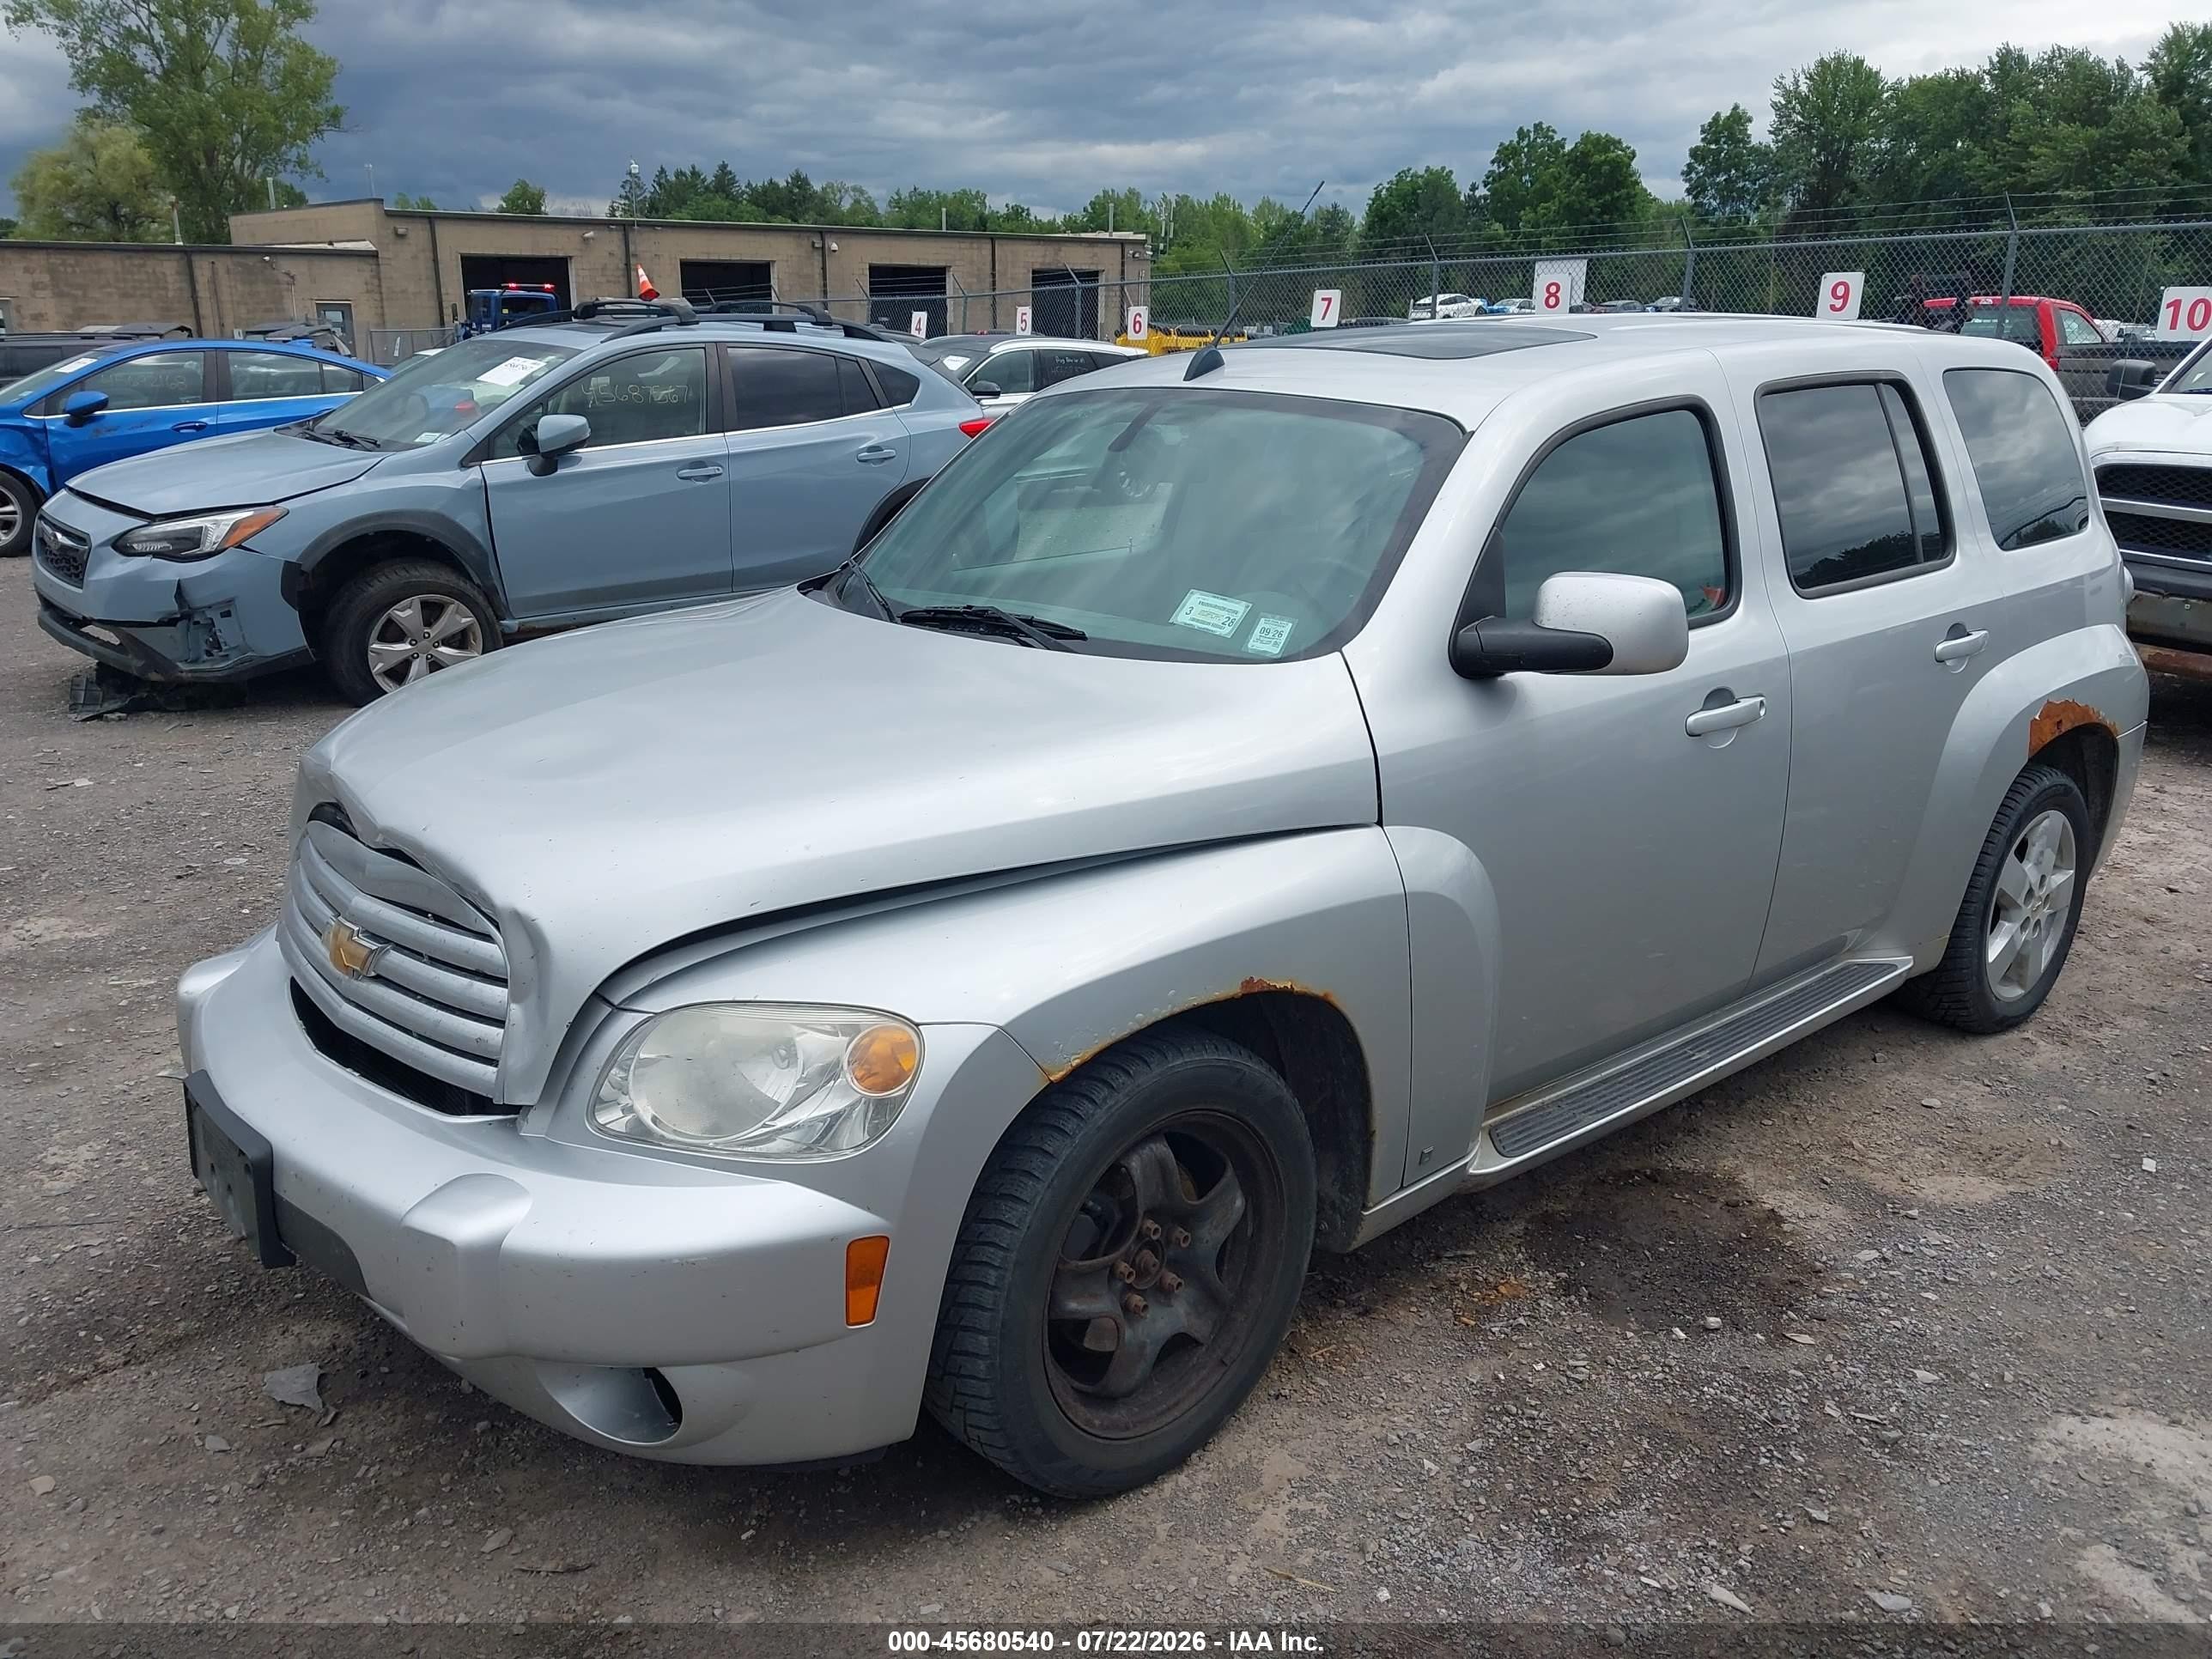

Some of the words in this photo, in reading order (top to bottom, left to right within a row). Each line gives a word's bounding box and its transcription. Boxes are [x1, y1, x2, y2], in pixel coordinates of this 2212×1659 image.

[1544, 281, 1561, 310] 8
[1829, 280, 1850, 313] 9
[1321, 296, 1334, 321] 7
[2165, 297, 2212, 331] 10
[915, 316, 922, 335] 4
[1019, 312, 1028, 332] 5
[1133, 312, 1143, 335] 6
[1185, 605, 1194, 616] 3
[1221, 616, 1237, 628] 28
